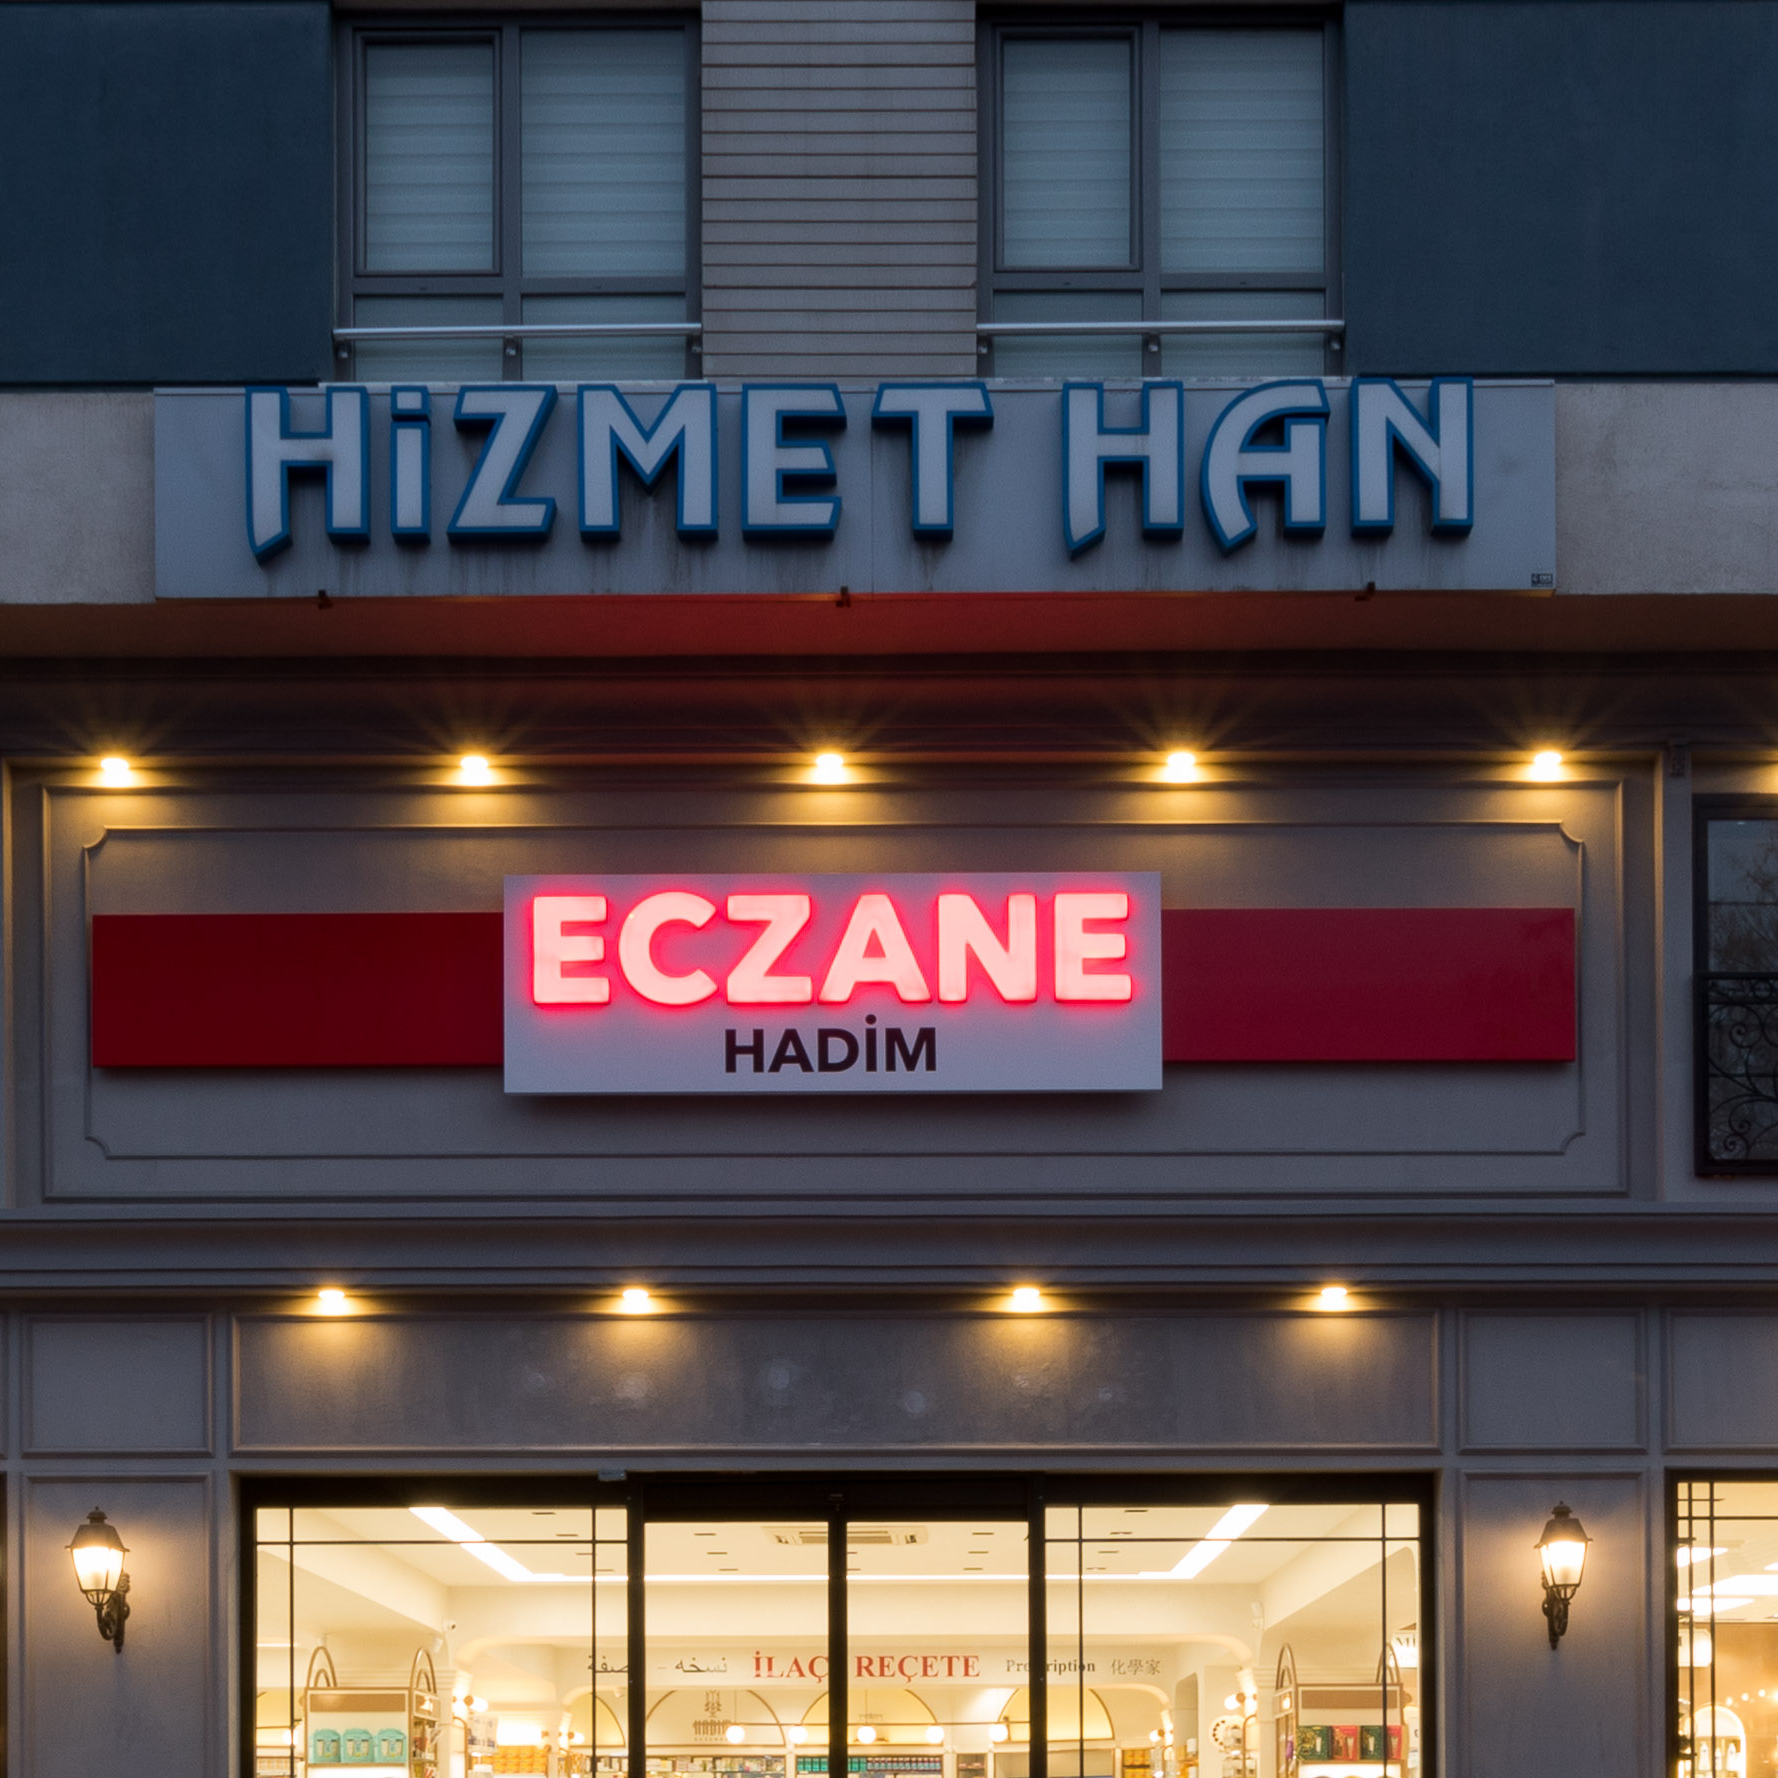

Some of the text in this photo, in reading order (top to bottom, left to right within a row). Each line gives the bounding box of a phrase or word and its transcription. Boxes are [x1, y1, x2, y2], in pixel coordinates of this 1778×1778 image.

[1061, 376, 1475, 559] HAN
[531, 890, 1132, 1006] ECZANE
[723, 1013, 938, 1074] HADİM
[754, 1651, 981, 1684] İLAÇ REÇETE
[1006, 1658, 1096, 1676] Preription
